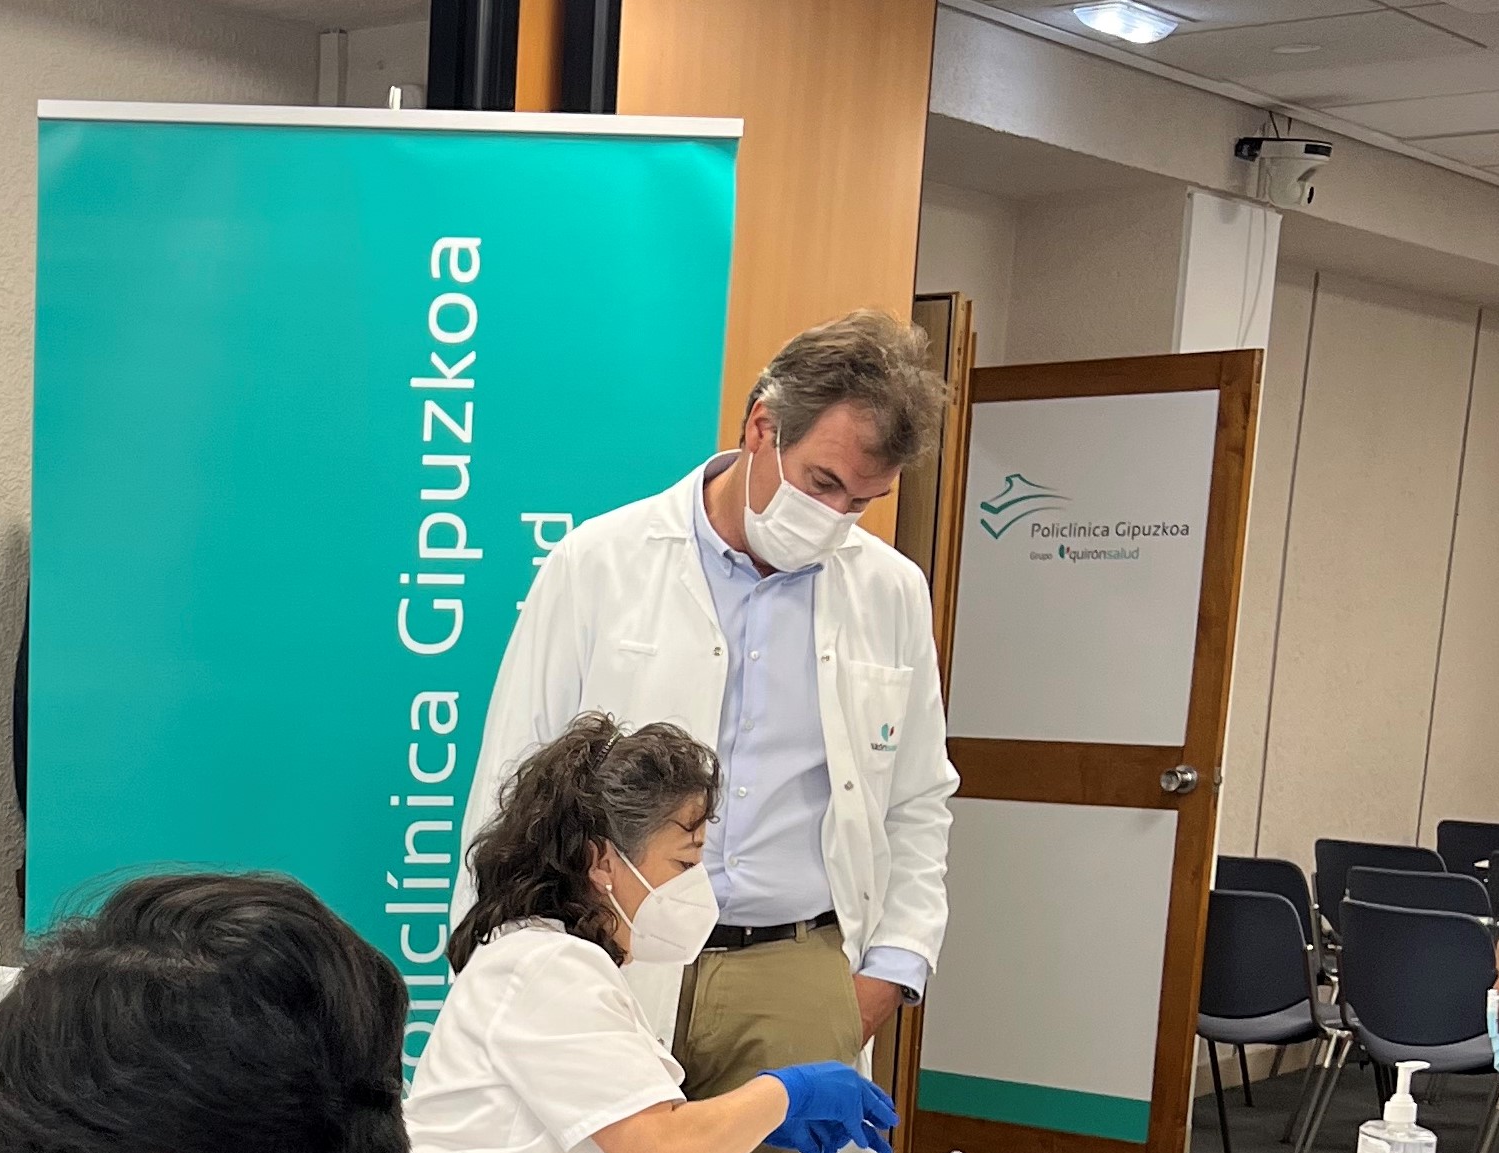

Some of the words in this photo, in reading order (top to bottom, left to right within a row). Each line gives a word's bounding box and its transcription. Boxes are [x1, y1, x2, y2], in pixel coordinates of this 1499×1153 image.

[397, 236, 483, 656] Gipuzkoa
[1115, 521, 1190, 541] Gipuzkoa
[385, 690, 460, 1098] oliclínica
